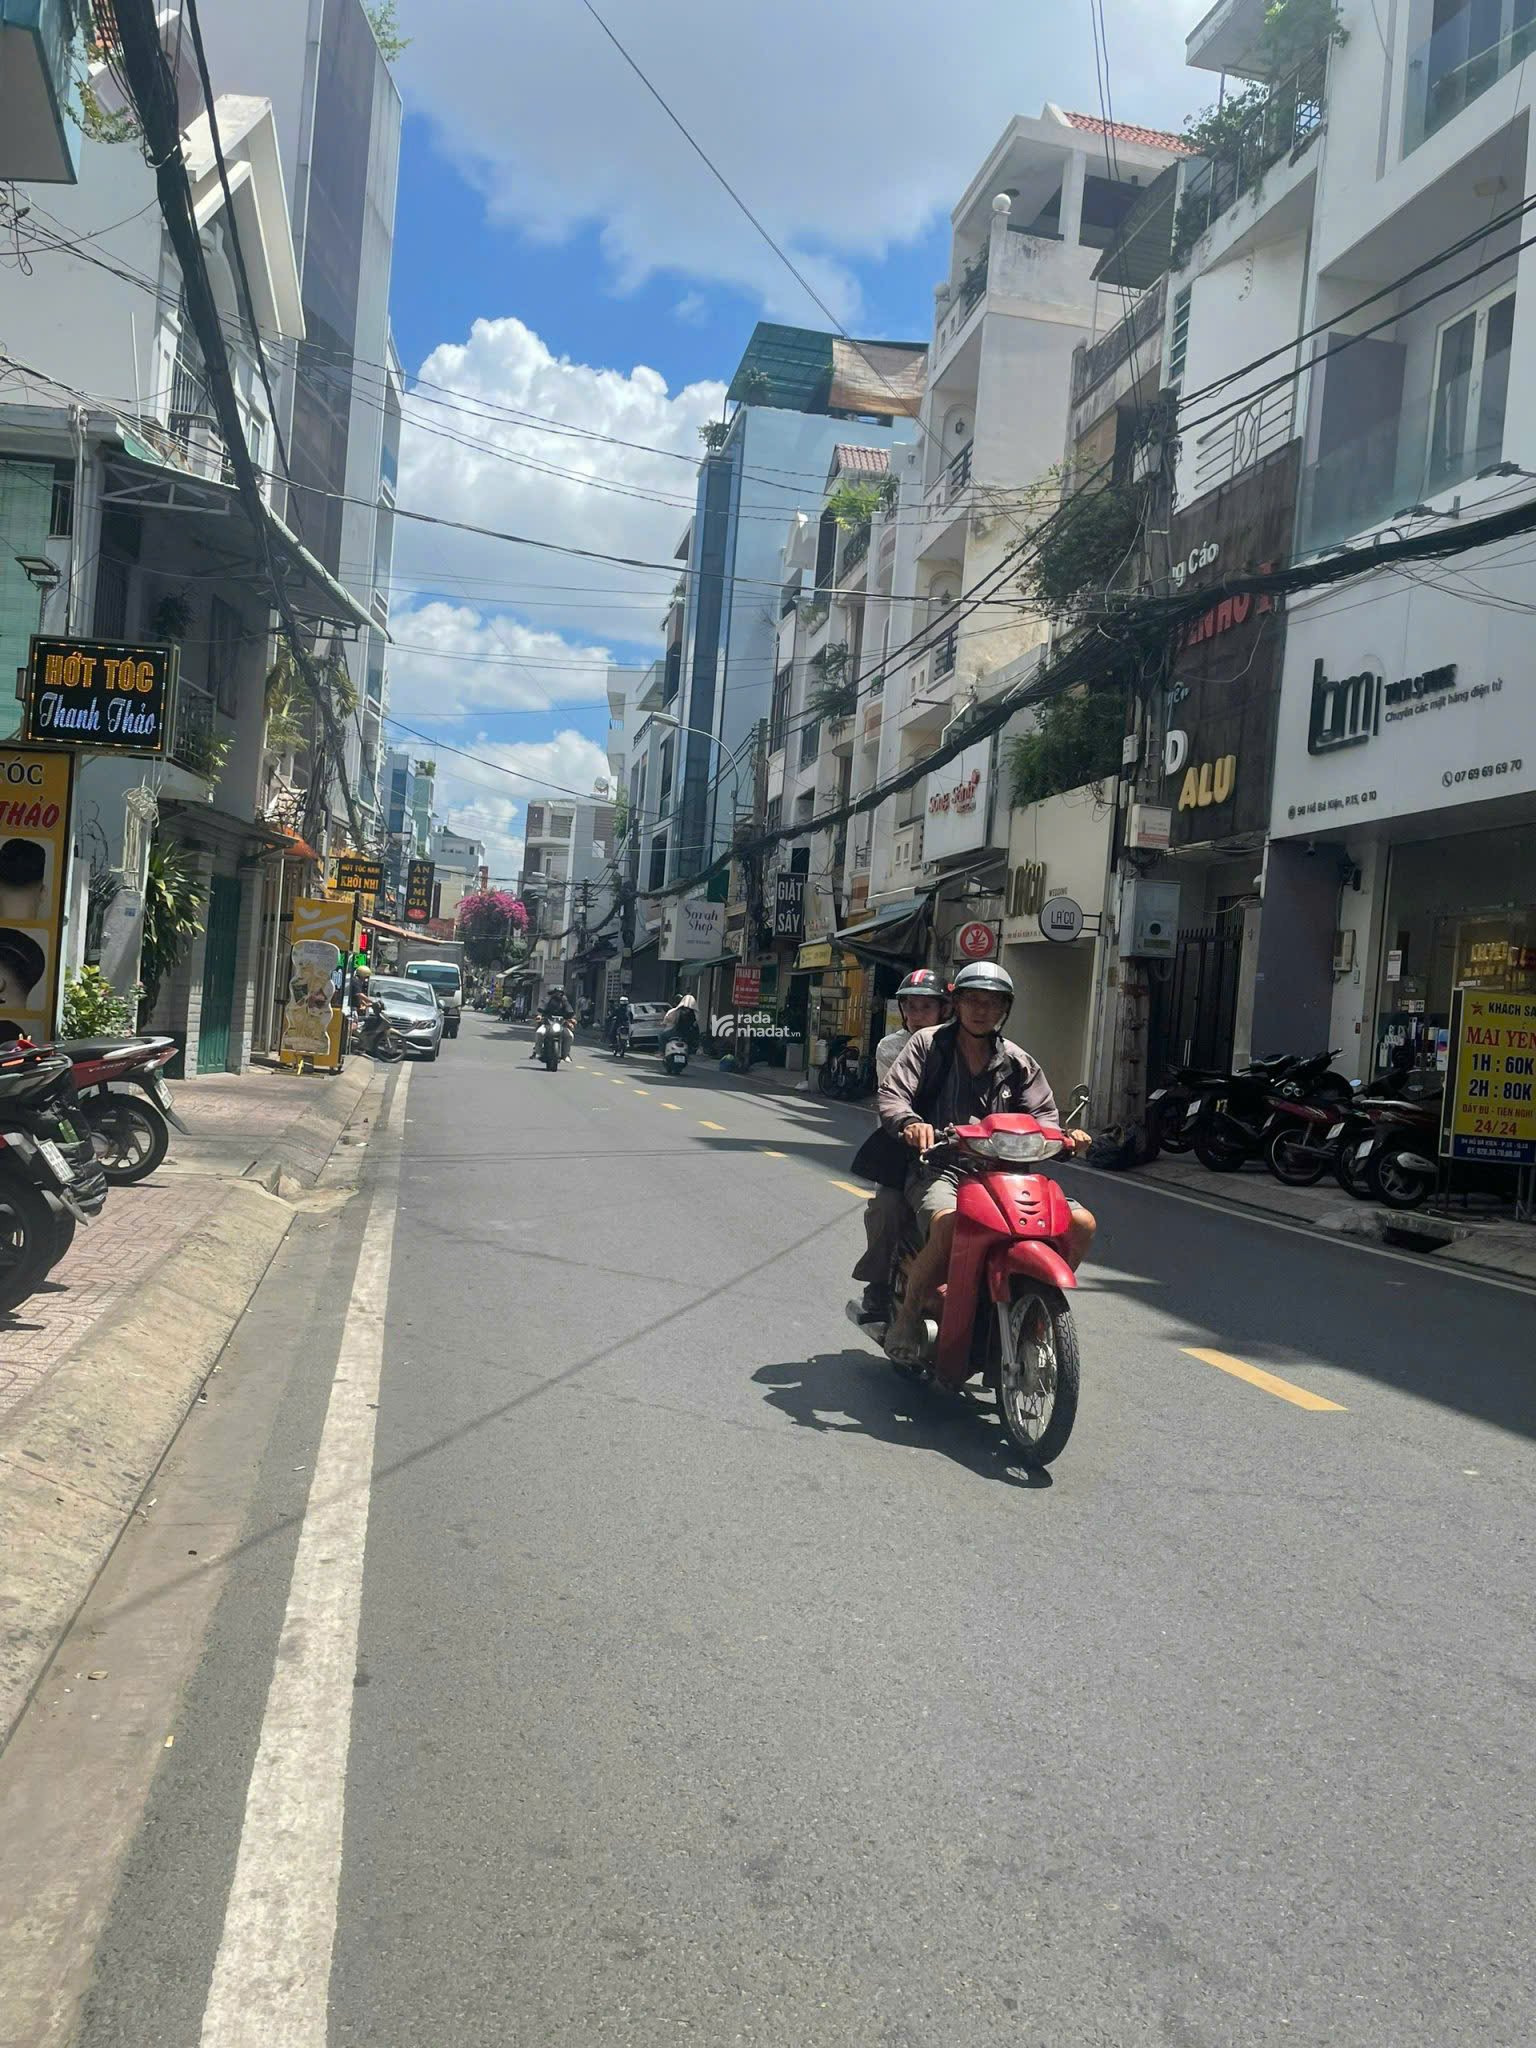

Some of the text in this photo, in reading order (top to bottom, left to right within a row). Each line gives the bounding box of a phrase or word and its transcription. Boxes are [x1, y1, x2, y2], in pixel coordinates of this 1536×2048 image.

[1188, 540, 1220, 575] Cáo
[45, 651, 154, 692] HỚT TÓC
[39, 692, 156, 735] Thanh Thảo
[1455, 759, 1522, 783] 07 69 69 69 70
[1178, 754, 1237, 812] ALU
[408, 897, 428, 907] GIA
[778, 879, 804, 905] GIẶT
[683, 904, 718, 922] Sarah
[778, 907, 801, 933] SẤY
[688, 919, 713, 936] Shop
[1488, 1001, 1521, 1016] KHÁCH
[1466, 1026, 1500, 1046] MAI
[1472, 1053, 1491, 1072] 1H
[1505, 1056, 1535, 1075] 60K
[1468, 1079, 1489, 1097] 2H
[1503, 1082, 1532, 1101] 80K
